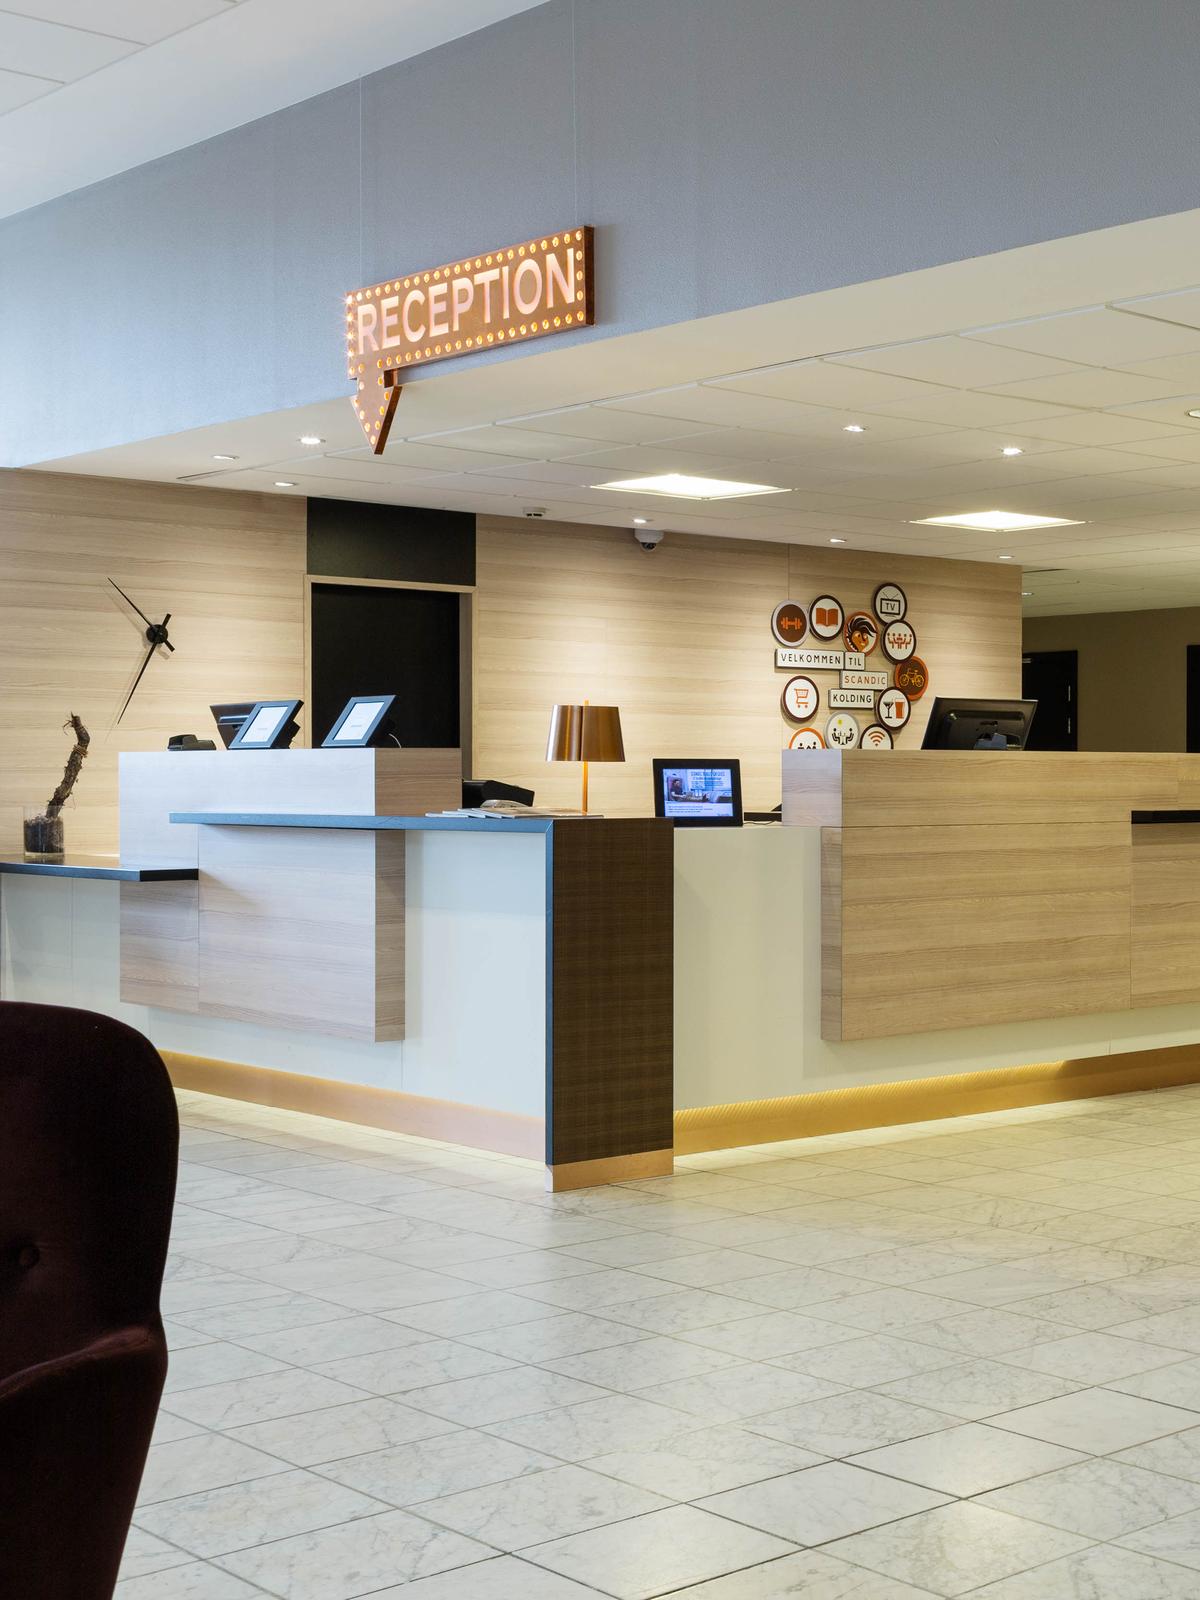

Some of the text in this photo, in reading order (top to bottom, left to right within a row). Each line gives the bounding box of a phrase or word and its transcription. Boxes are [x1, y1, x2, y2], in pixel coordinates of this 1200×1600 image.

[356, 247, 576, 355] RECEPTION
[885, 602, 896, 611] TV
[781, 653, 861, 666] VELKOMMEN TIL
[844, 675, 886, 685] SCANDIC
[833, 694, 872, 703] KOLDING
